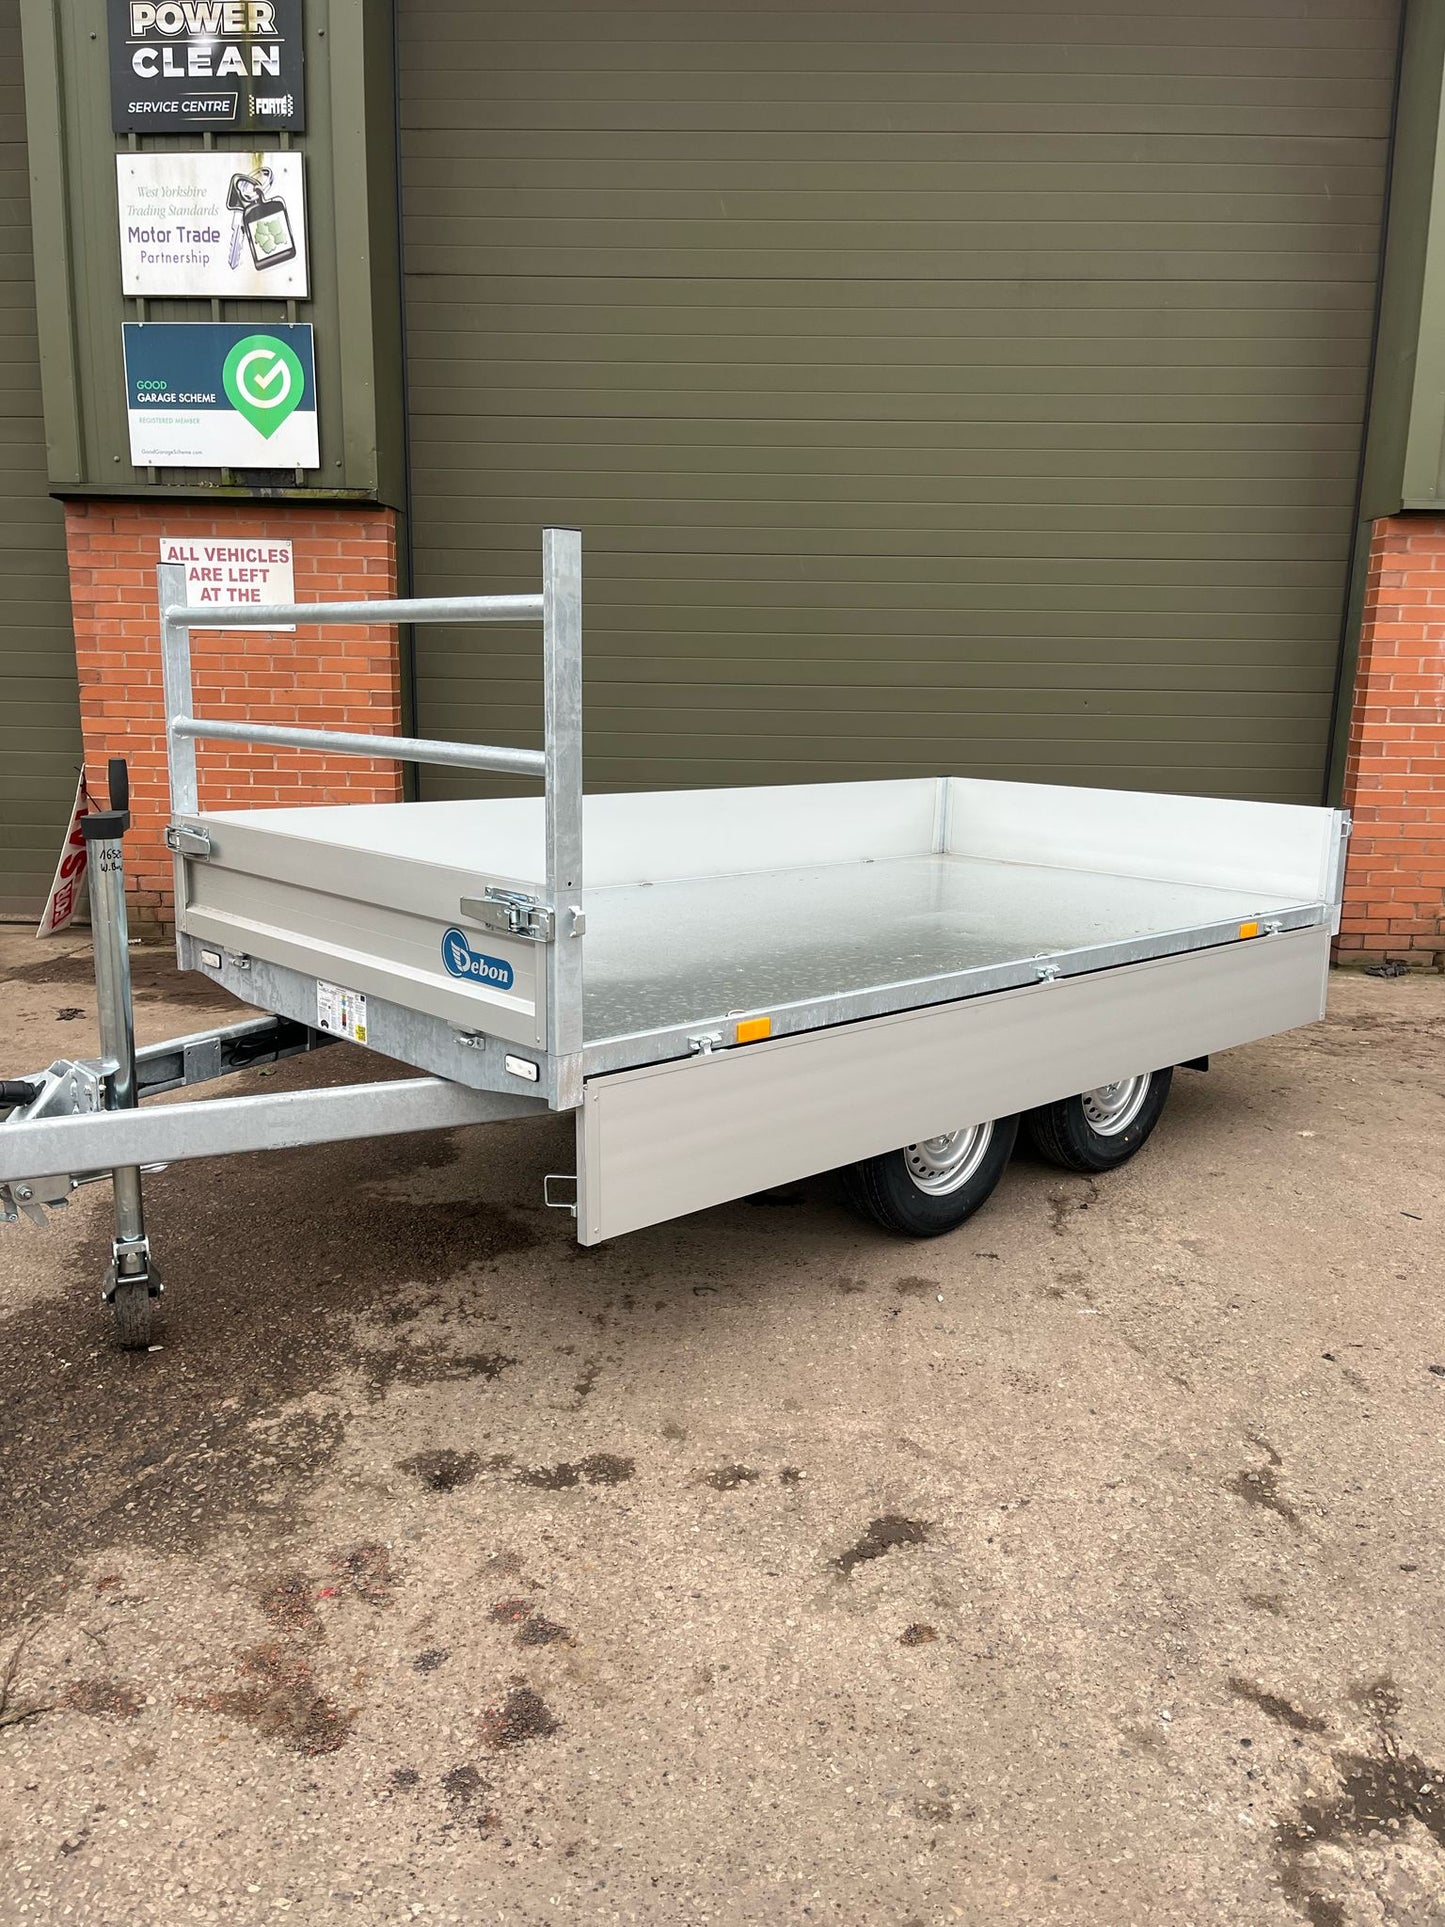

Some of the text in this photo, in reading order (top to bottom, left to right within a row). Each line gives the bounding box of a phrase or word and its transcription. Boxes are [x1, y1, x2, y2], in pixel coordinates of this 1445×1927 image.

[130, 1, 279, 36] POWER
[132, 46, 280, 78] CLEAN
[128, 100, 230, 113] SERVICE CENTRE
[137, 185, 207, 198] West Yorkshire
[127, 204, 219, 219] Trading Standards
[128, 226, 220, 243] Motor Trade
[140, 250, 210, 267] Partnership
[136, 380, 167, 390] GOOD
[137, 393, 216, 403] GARAGE SCHEME
[167, 546, 289, 563] ALL VEHICLES
[189, 567, 270, 582] ARE LEFT
[200, 588, 261, 602] AT THE
[451, 940, 509, 983] Debon
